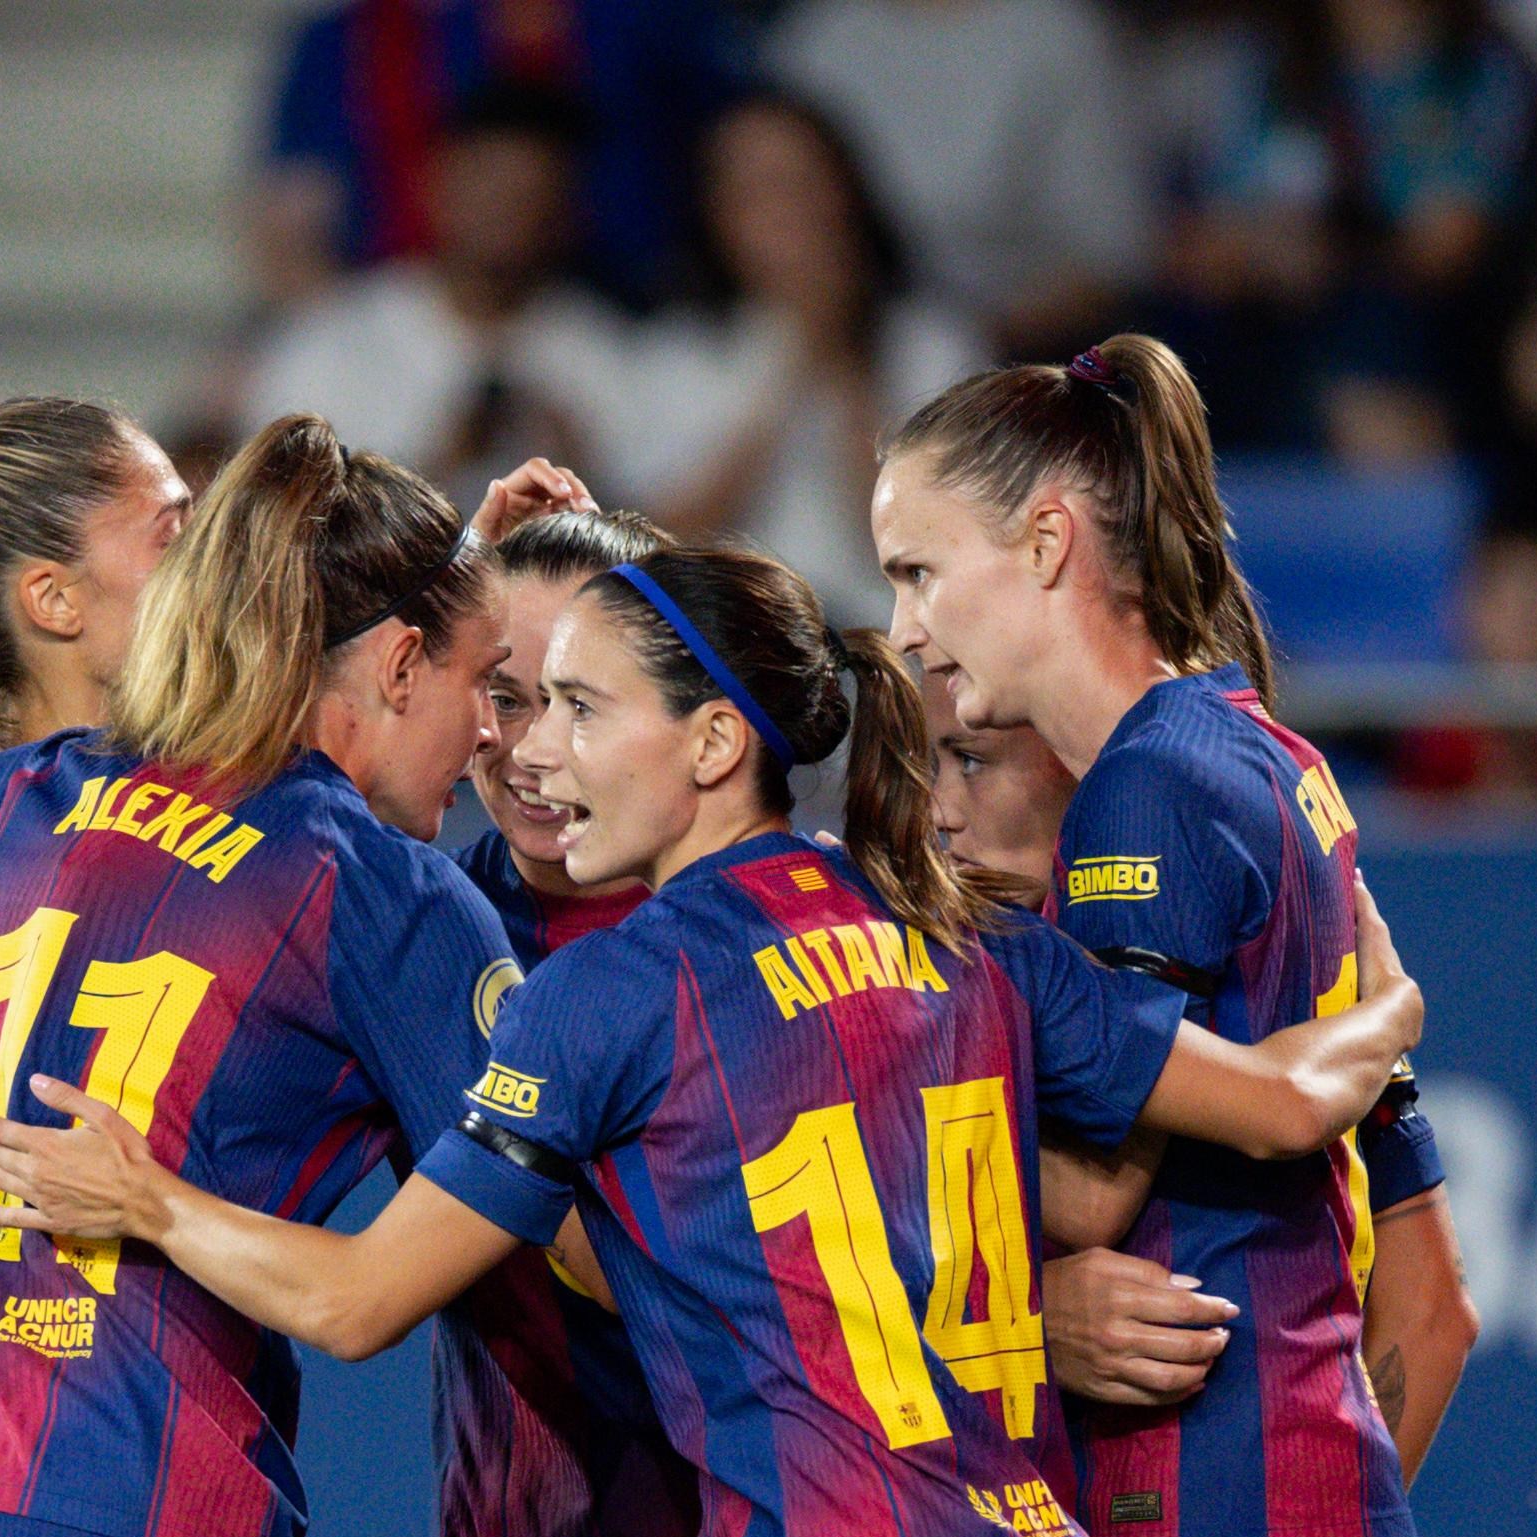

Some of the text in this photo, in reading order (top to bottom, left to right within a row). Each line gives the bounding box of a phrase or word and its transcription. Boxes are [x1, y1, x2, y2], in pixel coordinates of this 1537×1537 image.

[53, 776, 265, 884] ALEXIA
[1068, 863, 1159, 897] BIMBO
[753, 921, 949, 1020] AITANA
[4, 1296, 97, 1323] UNHCR
[741, 1076, 1047, 1450] 14
